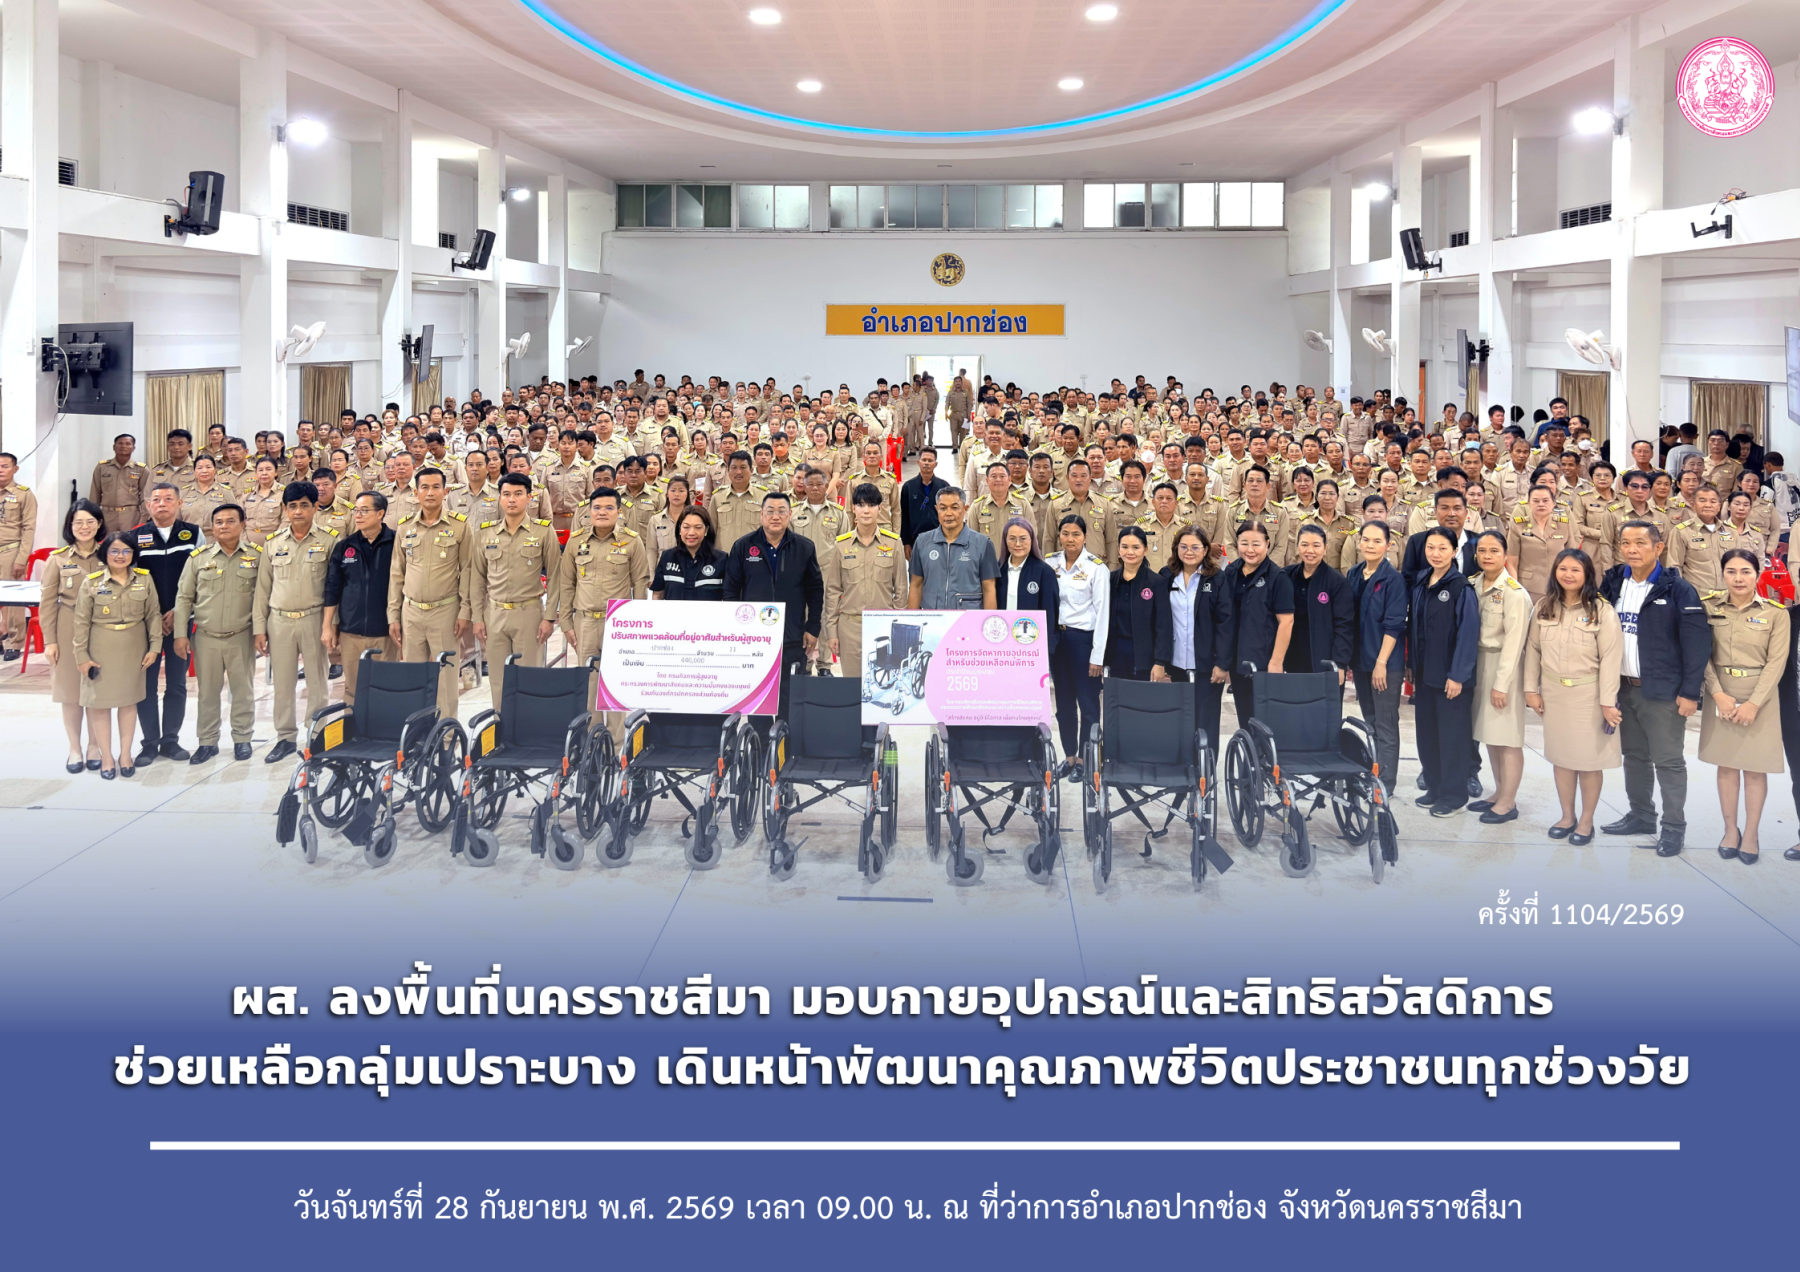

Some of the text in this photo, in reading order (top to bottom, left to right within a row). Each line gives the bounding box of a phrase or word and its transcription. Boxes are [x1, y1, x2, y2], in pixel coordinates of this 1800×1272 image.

[861, 306, 1028, 333] อำเภอปากช่อง
[612, 618, 654, 628] โครงการ
[611, 630, 772, 645] ปรับสภาพแวดล้อมที่อยู่อาศัยสำหรับผู้สูงอายุ
[946, 648, 1040, 659] โครงการจัดหากายอุปกรณ์
[946, 658, 1036, 667] สำหรับช่วยเหลือคนพิการ
[947, 676, 979, 691] 2569
